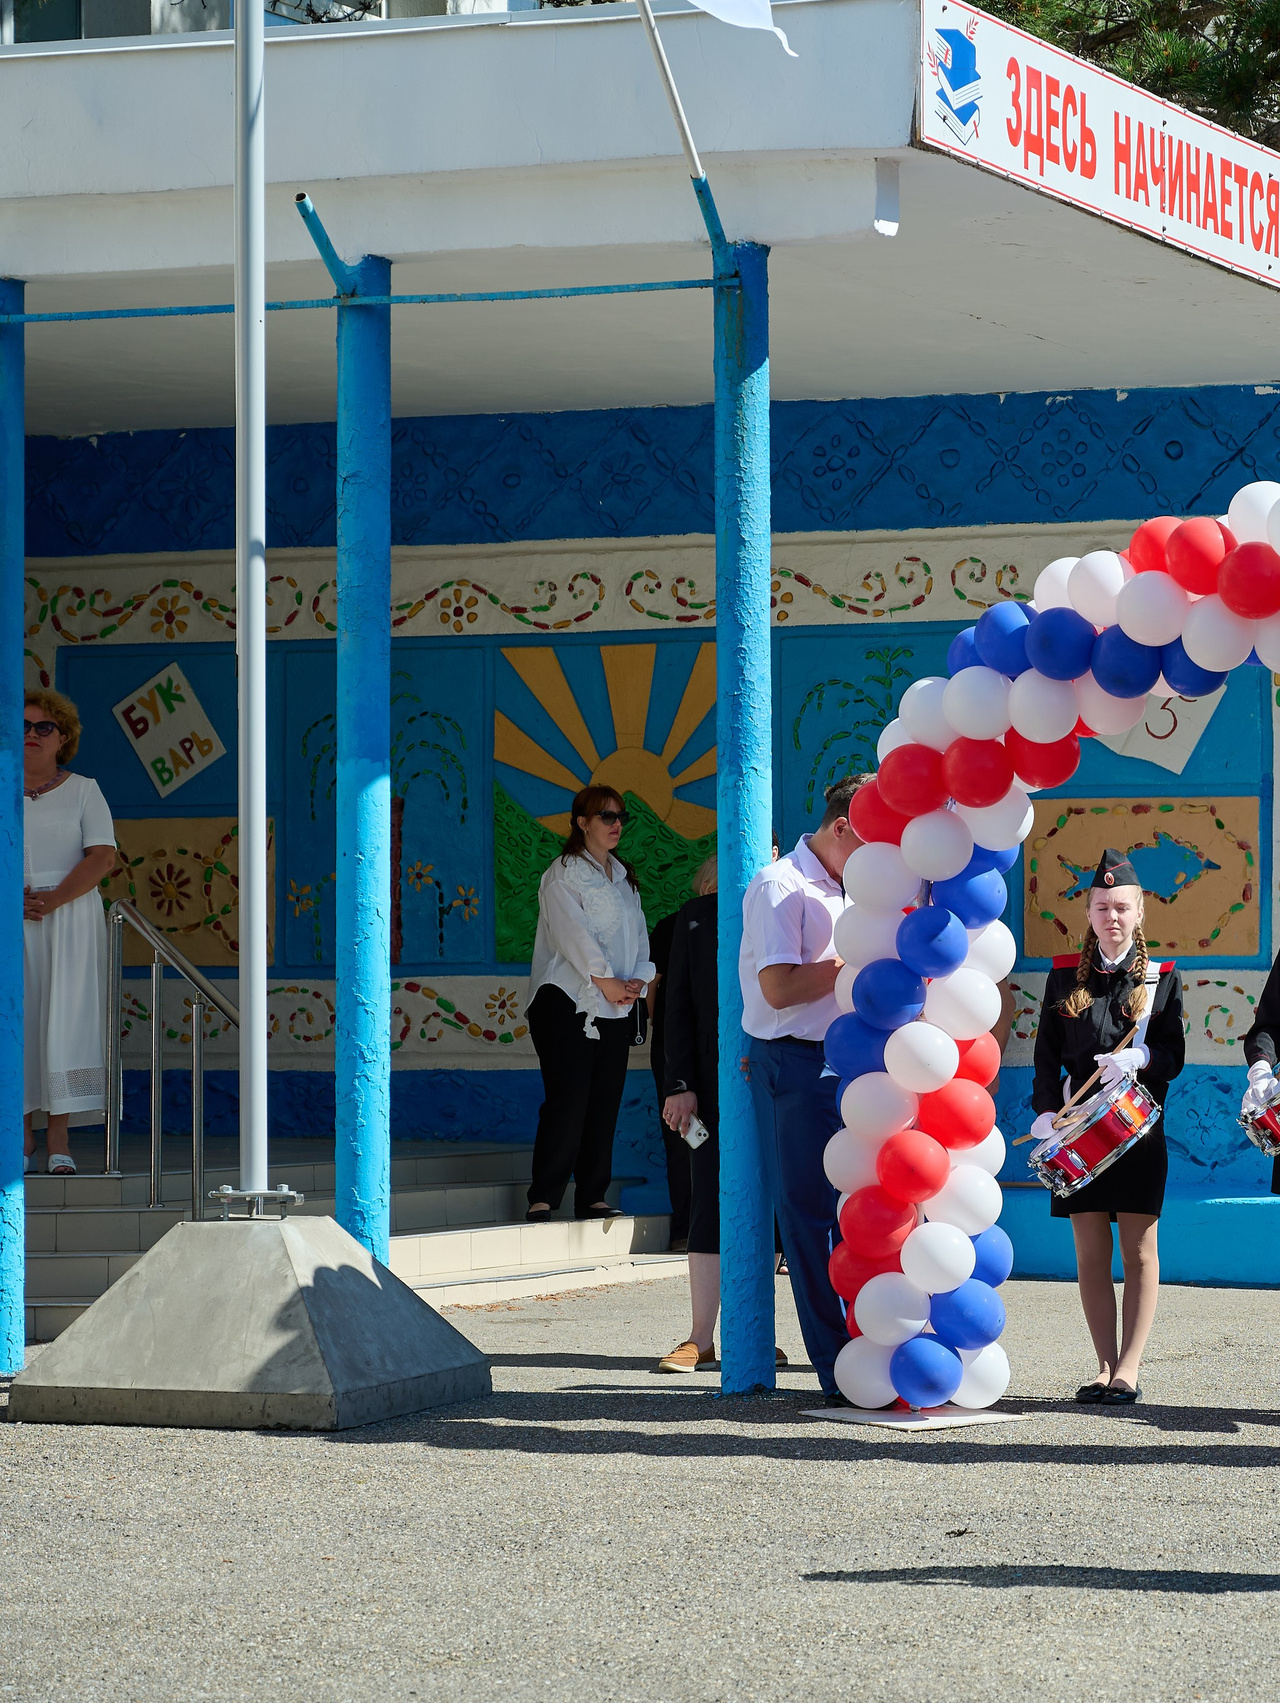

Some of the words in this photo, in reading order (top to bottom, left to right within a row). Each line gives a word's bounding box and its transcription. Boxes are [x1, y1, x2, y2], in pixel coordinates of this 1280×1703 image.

[1006, 57, 1097, 180] ЗДЕСЬ
[1114, 110, 1280, 258] НАЧИНАЕТСЯ
[151, 731, 214, 787] ВАРЬ
